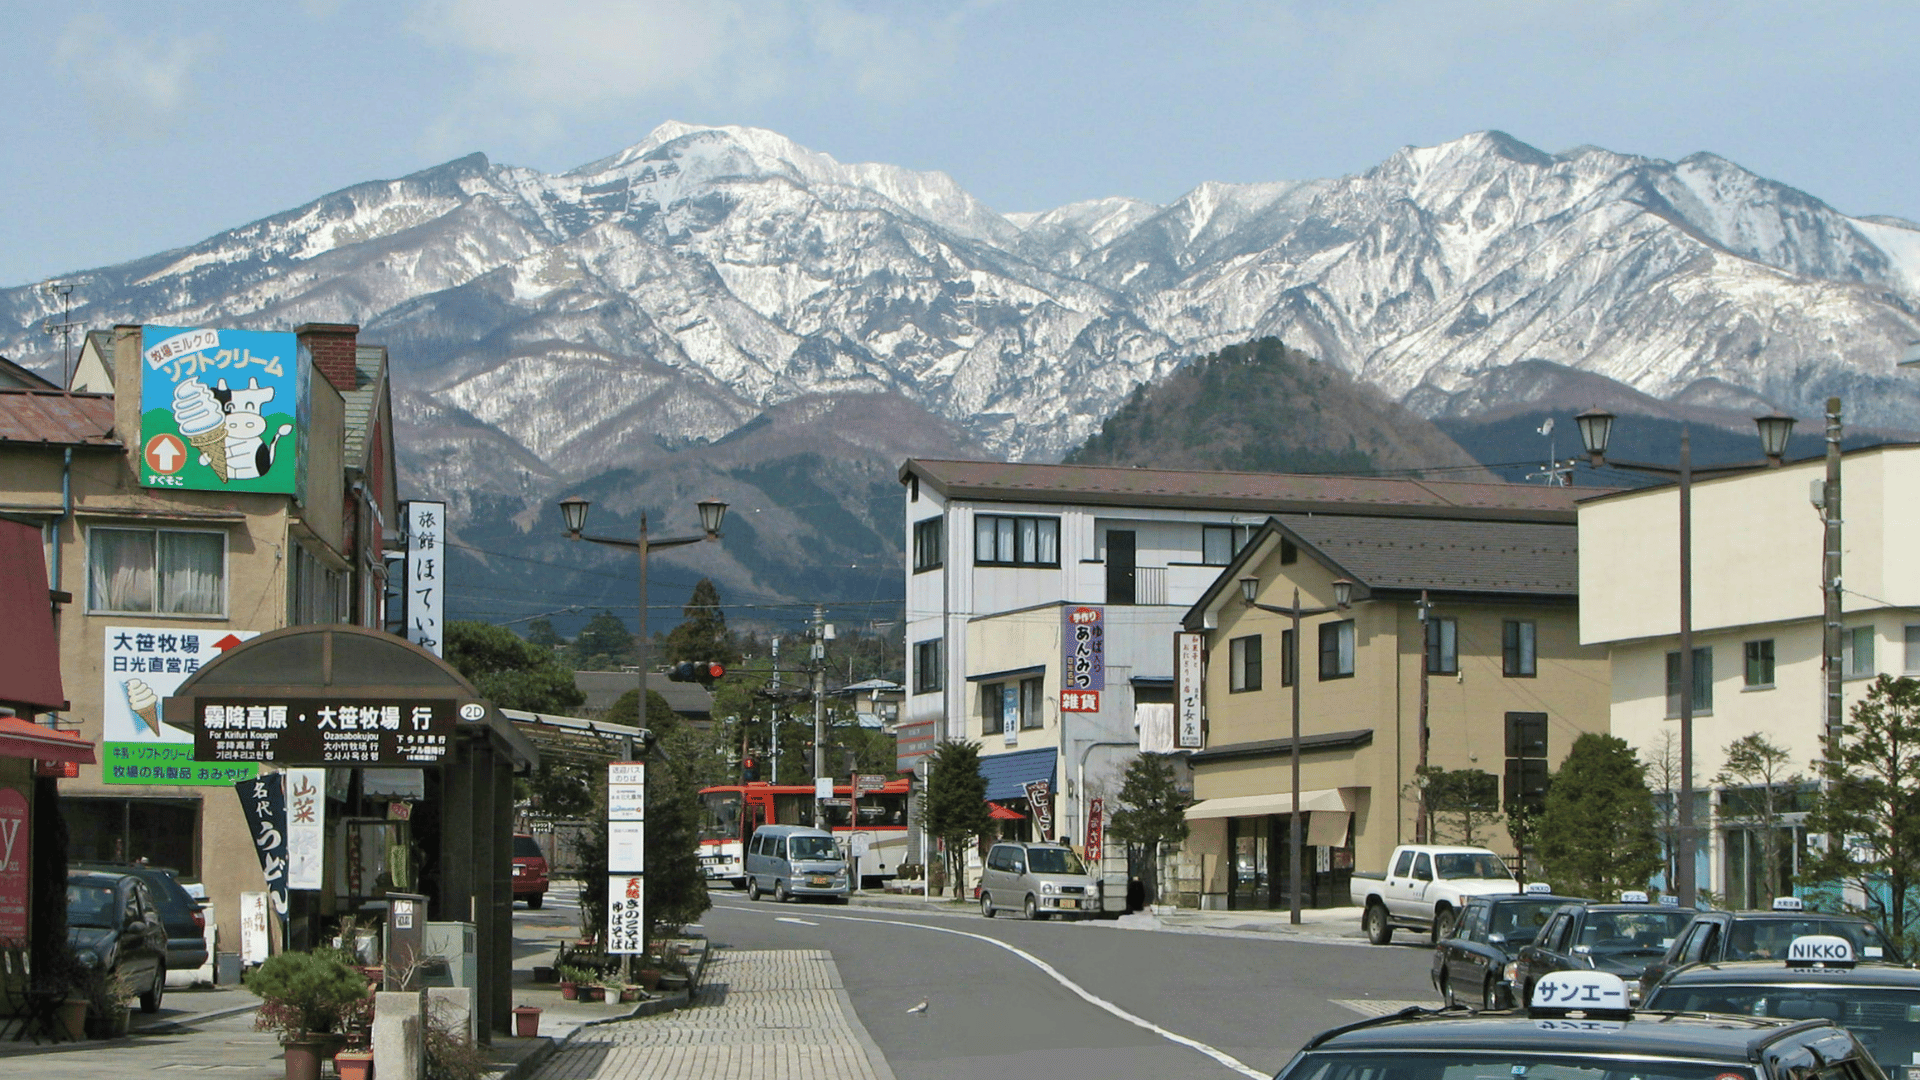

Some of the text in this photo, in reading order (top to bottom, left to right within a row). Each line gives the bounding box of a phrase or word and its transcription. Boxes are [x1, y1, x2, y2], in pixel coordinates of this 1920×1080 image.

[150, 332, 216, 363] 牧場ミルクの
[163, 348, 284, 382] ソフトクリーム
[1072, 611, 1097, 623] 手作り
[113, 632, 200, 654] 大笹牧場
[113, 656, 200, 673] 日光直営店
[1076, 625, 1091, 689] あんみつ
[465, 706, 482, 718] 2D
[1062, 693, 1097, 710] 雑貨
[412, 706, 432, 730] 行
[1183, 697, 1195, 735] 乙女屋
[209, 731, 278, 741] For Kirifuri Kougen
[323, 732, 379, 742] Ozasabokujou
[113, 765, 250, 781] 牧場の乳製品 おみやげ
[293, 774, 317, 823] 山菜
[611, 901, 624, 950] ゆばそば
[1793, 944, 1848, 959] NIKKO
[1538, 981, 1620, 1002] サンエー
